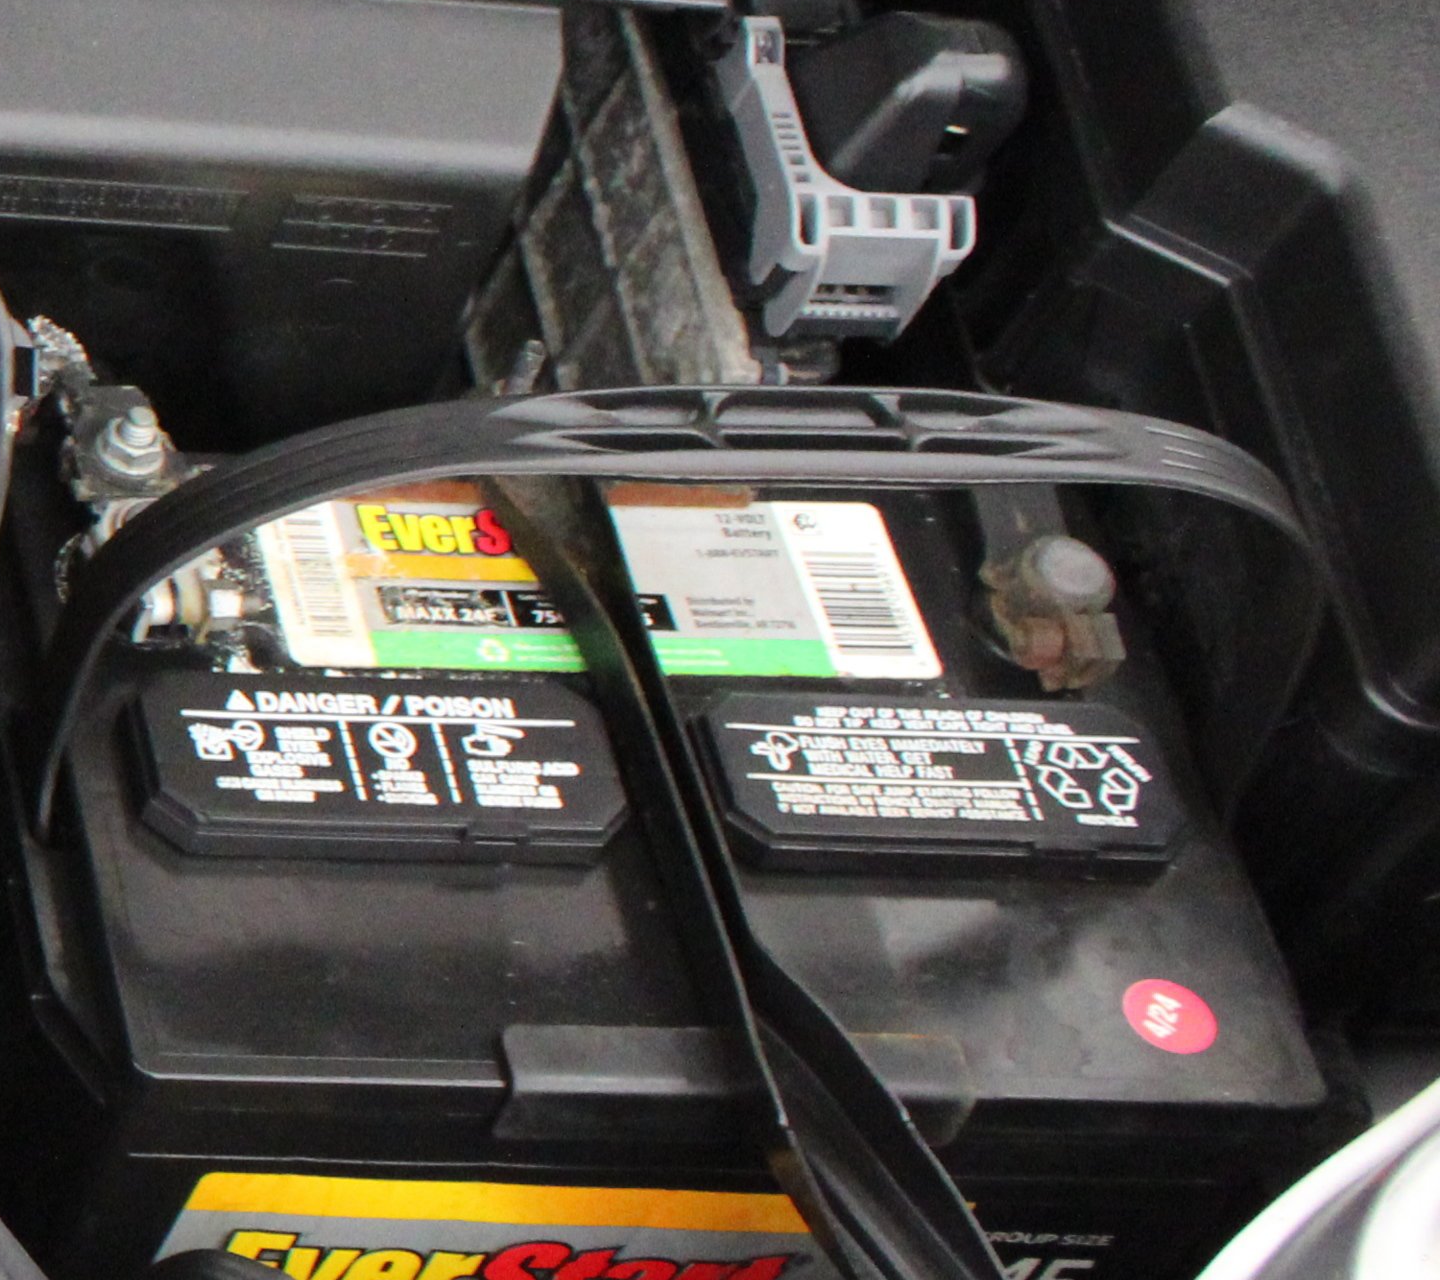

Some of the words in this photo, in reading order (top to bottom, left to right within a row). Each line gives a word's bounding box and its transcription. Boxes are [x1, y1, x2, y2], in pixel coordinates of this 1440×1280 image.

[356, 503, 512, 556] EverS
[255, 691, 379, 715] DANGER
[381, 695, 401, 715] /
[404, 695, 516, 719] POISON
[798, 734, 848, 751] FLUSH
[848, 736, 888, 752] EYES
[889, 738, 985, 754] IMMEDIATELY
[246, 750, 331, 767] EXPLOSIVE
[802, 749, 844, 764] WITH
[901, 751, 932, 766] GET
[808, 762, 874, 778] MEDICAL
[874, 764, 914, 779] HELP
[915, 765, 953, 780] FAST
[1141, 991, 1184, 1039] 4/24
